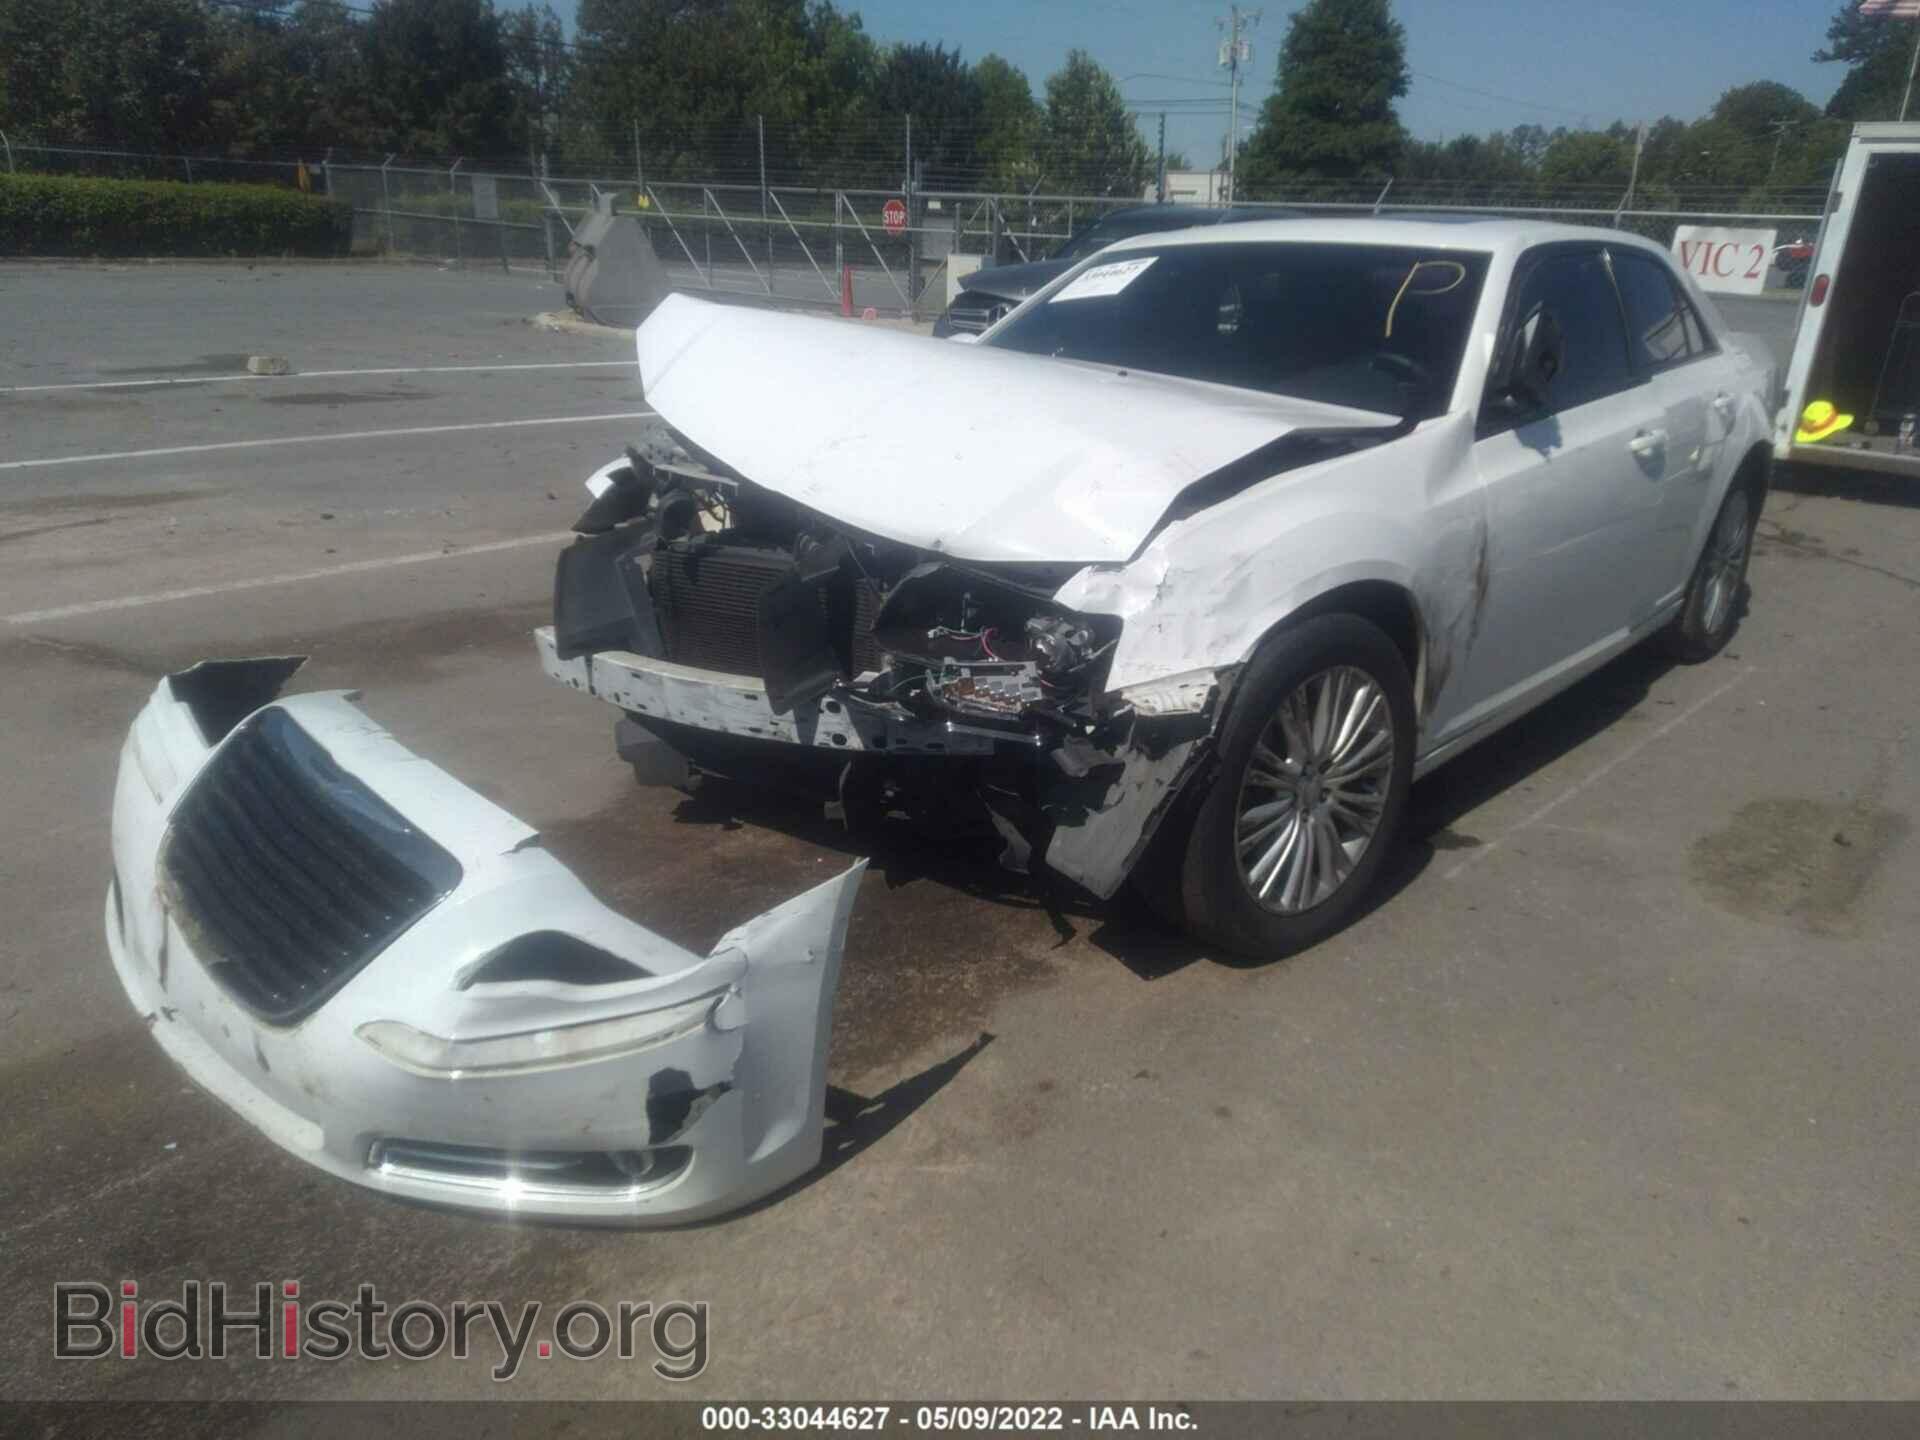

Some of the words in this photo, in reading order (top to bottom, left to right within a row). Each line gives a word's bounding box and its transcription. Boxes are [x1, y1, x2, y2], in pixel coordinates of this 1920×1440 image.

[884, 209, 906, 225] STOP
[1680, 239, 1739, 278] VIC
[1743, 243, 1764, 279] 2
